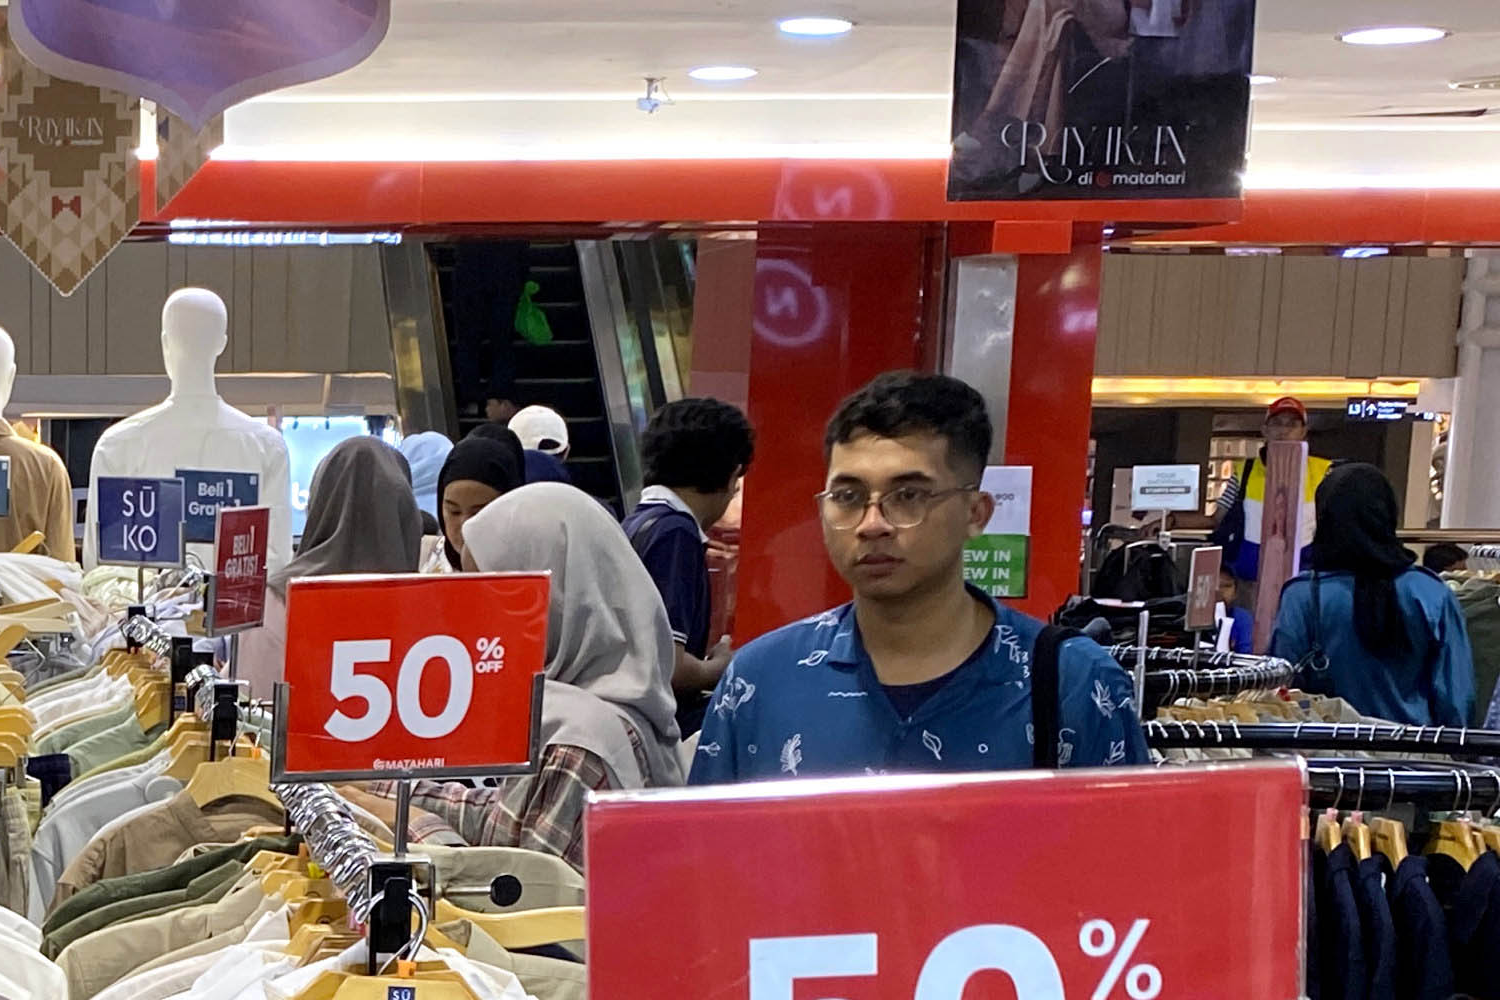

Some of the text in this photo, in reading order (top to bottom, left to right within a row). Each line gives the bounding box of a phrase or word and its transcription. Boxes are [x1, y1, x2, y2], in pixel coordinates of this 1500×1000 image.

[1078, 170, 1186, 186] di matahari
[198, 479, 234, 498] Beli 1
[123, 525, 157, 552] KO
[233, 534, 250, 556] BELI
[963, 550, 1011, 562] EW IN
[963, 568, 1010, 580] EW IN
[475, 661, 504, 673] OFF
[386, 758, 445, 770] MATAHARI
